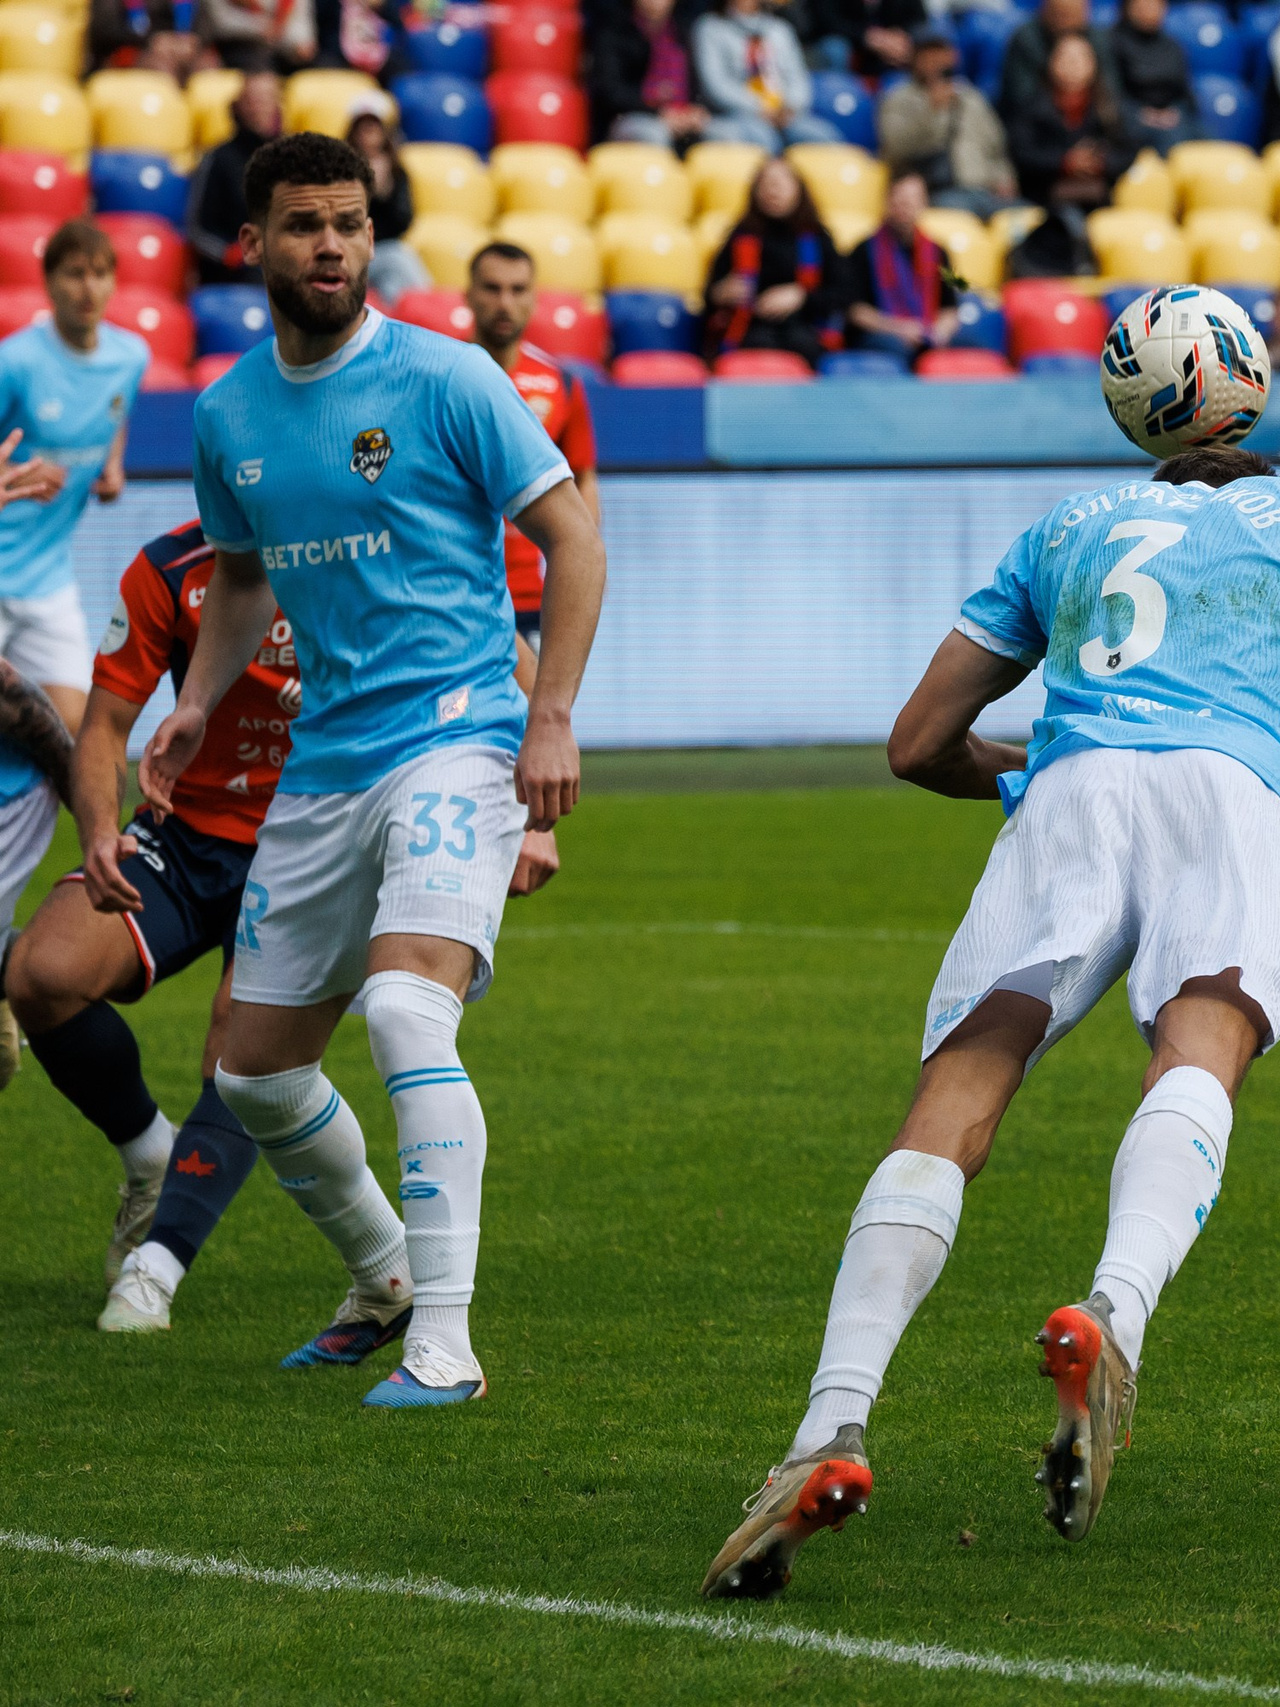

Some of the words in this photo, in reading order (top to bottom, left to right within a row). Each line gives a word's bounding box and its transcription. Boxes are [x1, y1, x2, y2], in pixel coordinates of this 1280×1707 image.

[262, 529, 391, 570] БЕТСИТИ
[1079, 519, 1188, 676] 3
[407, 792, 477, 861] 33
